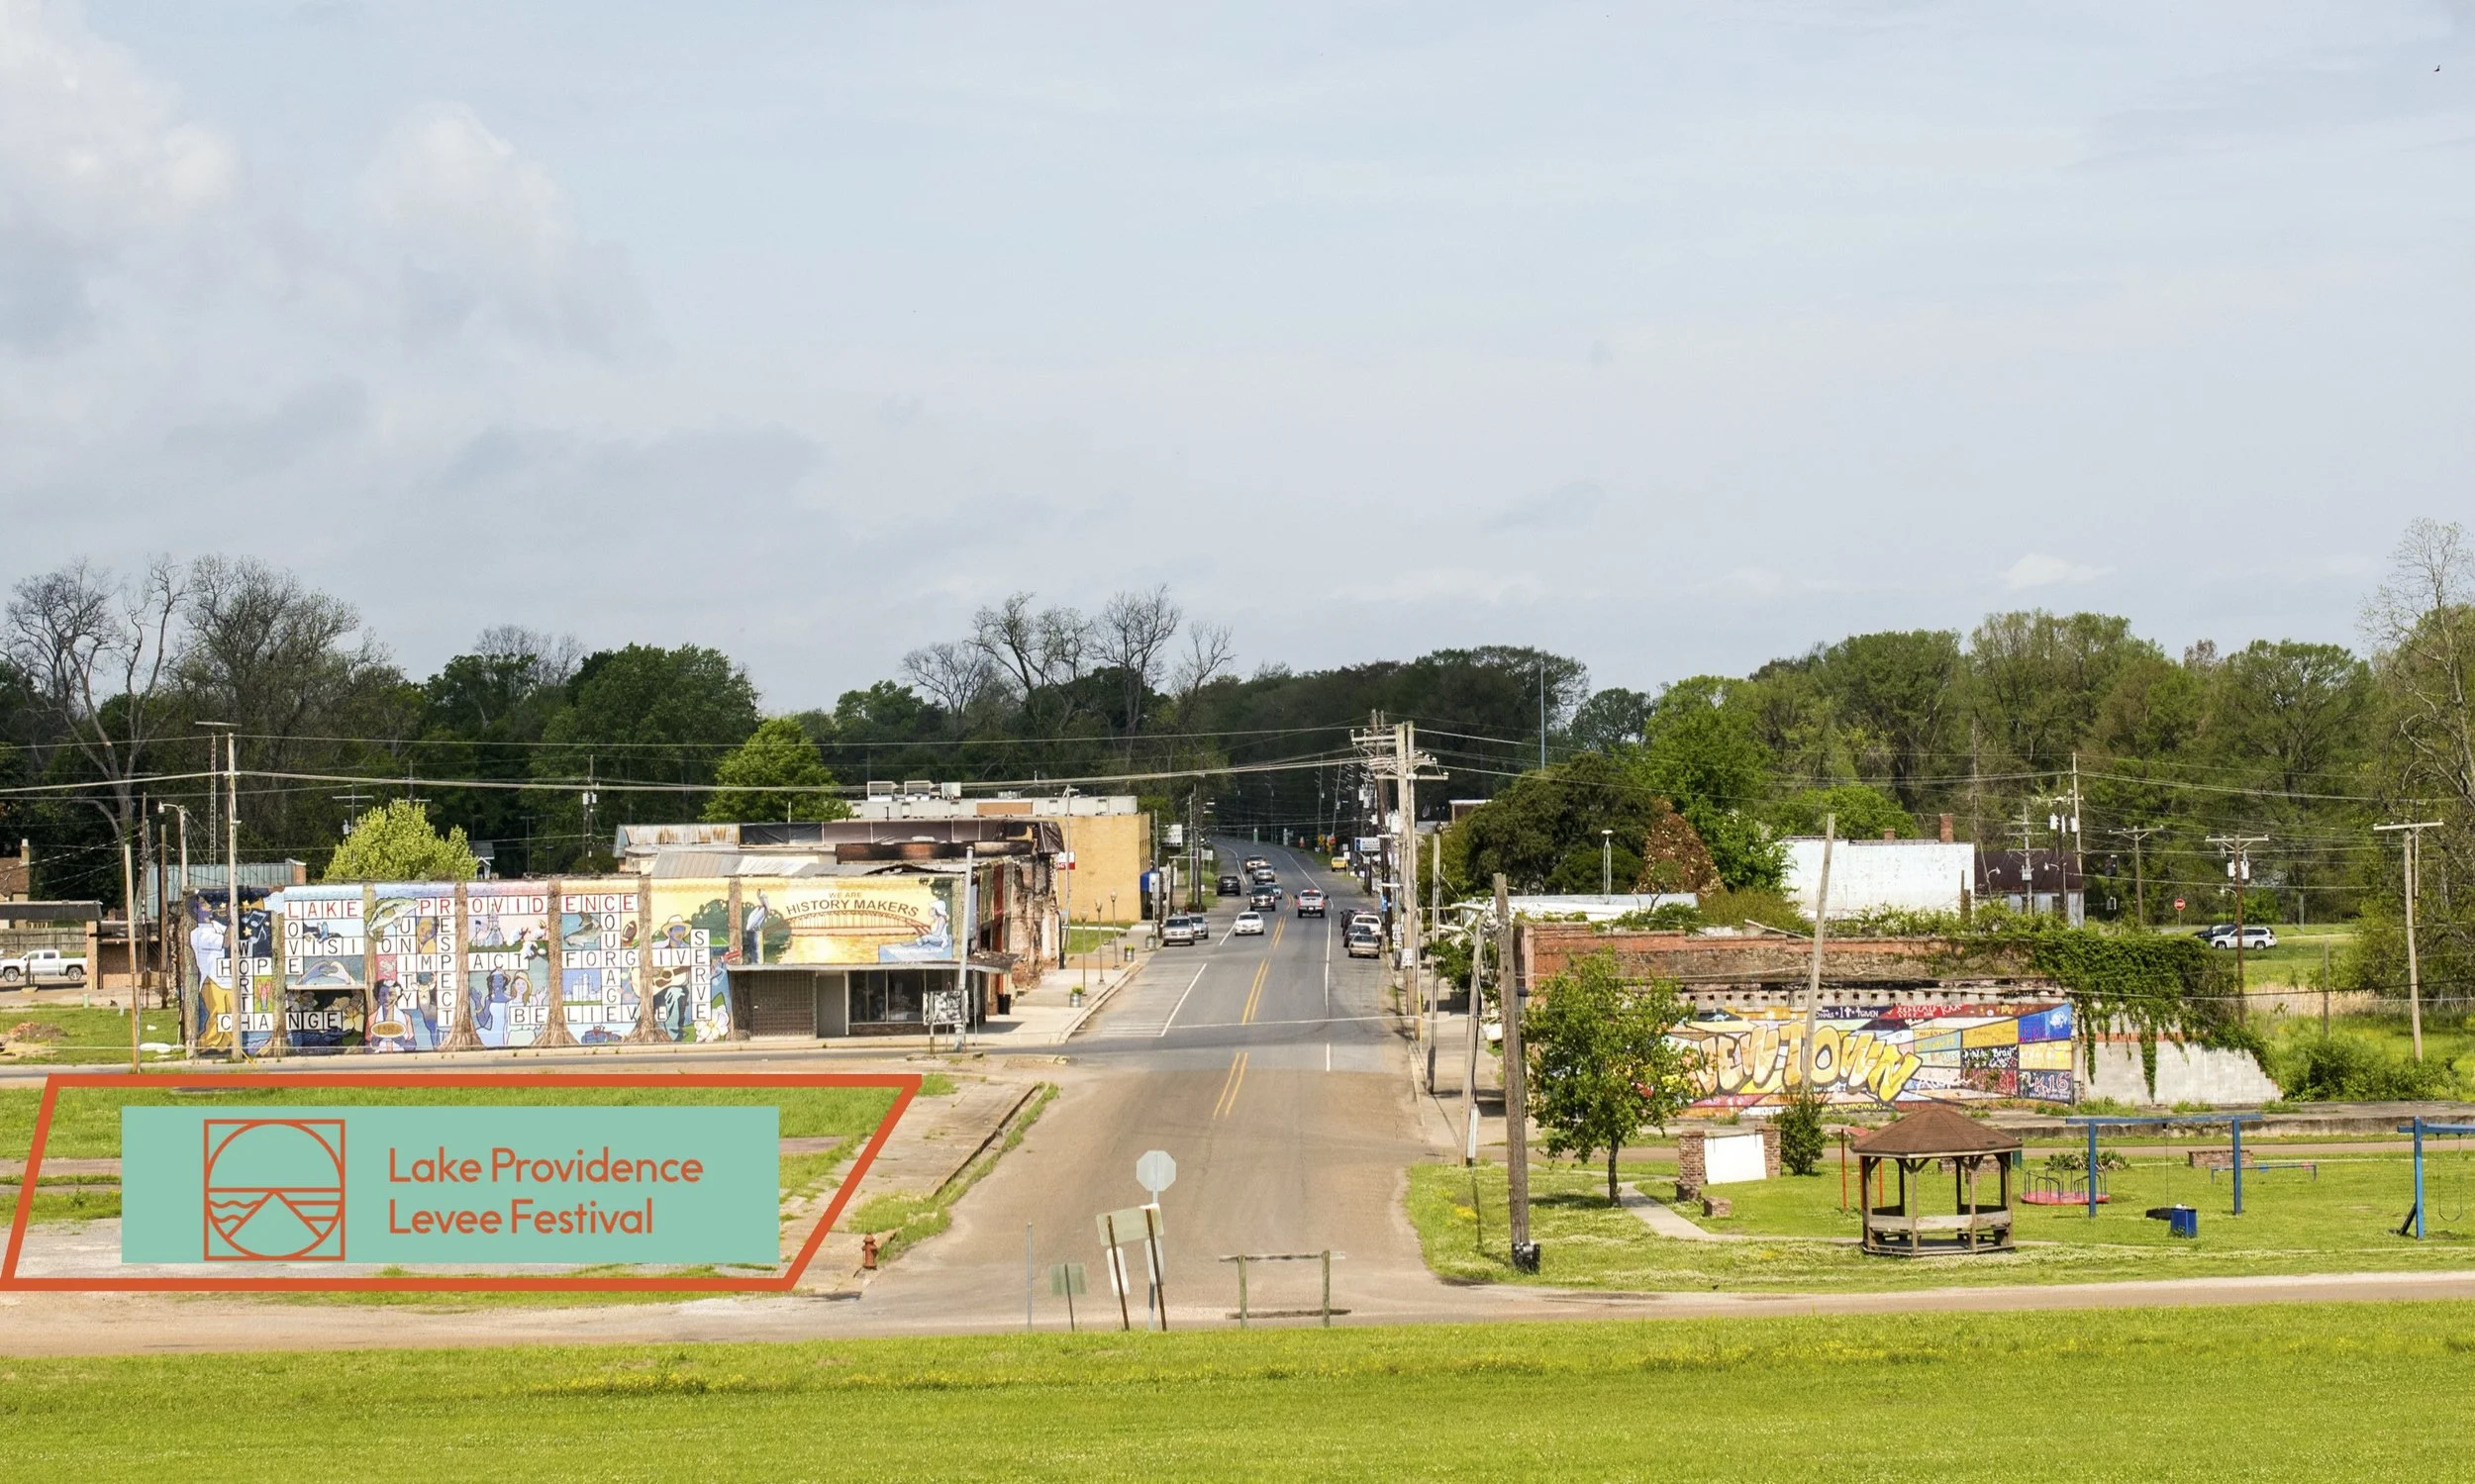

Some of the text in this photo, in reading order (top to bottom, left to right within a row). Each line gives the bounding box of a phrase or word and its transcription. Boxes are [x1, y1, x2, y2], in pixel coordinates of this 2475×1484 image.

[287, 894, 635, 919] LAKE PROVIDENCE
[287, 900, 300, 974] LOVE
[786, 899, 919, 917] HISTORY MAKERS
[400, 918, 412, 1008] UNITY
[440, 900, 452, 1026] RESPECT
[604, 896, 618, 1022] COURAGE
[694, 931, 706, 1020] SERVE
